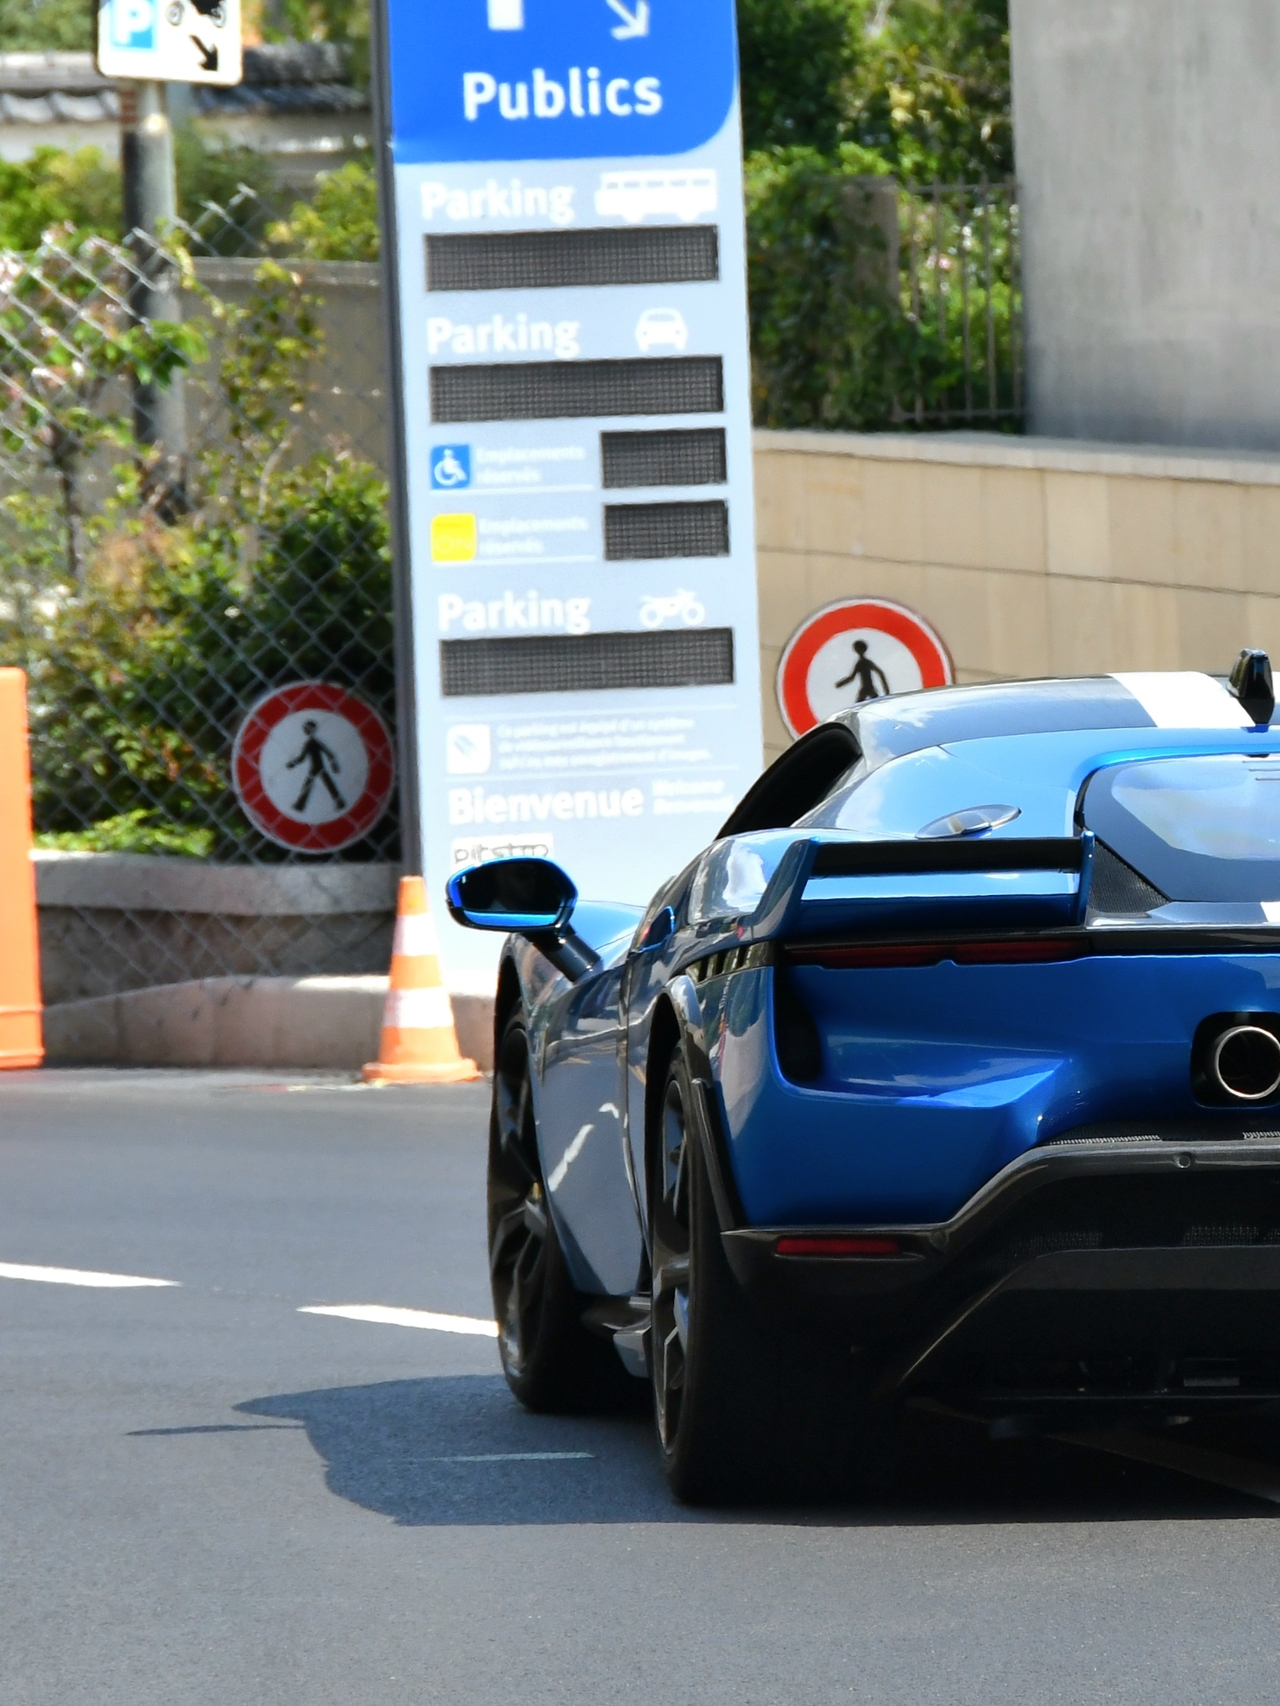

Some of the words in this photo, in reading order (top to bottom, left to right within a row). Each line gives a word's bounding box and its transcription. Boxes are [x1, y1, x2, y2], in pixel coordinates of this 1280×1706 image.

[463, 67, 662, 121] Publics
[420, 178, 576, 225] Parking
[426, 313, 581, 359] Parking
[437, 589, 592, 635] Parking
[449, 786, 645, 826] Bienvenue
